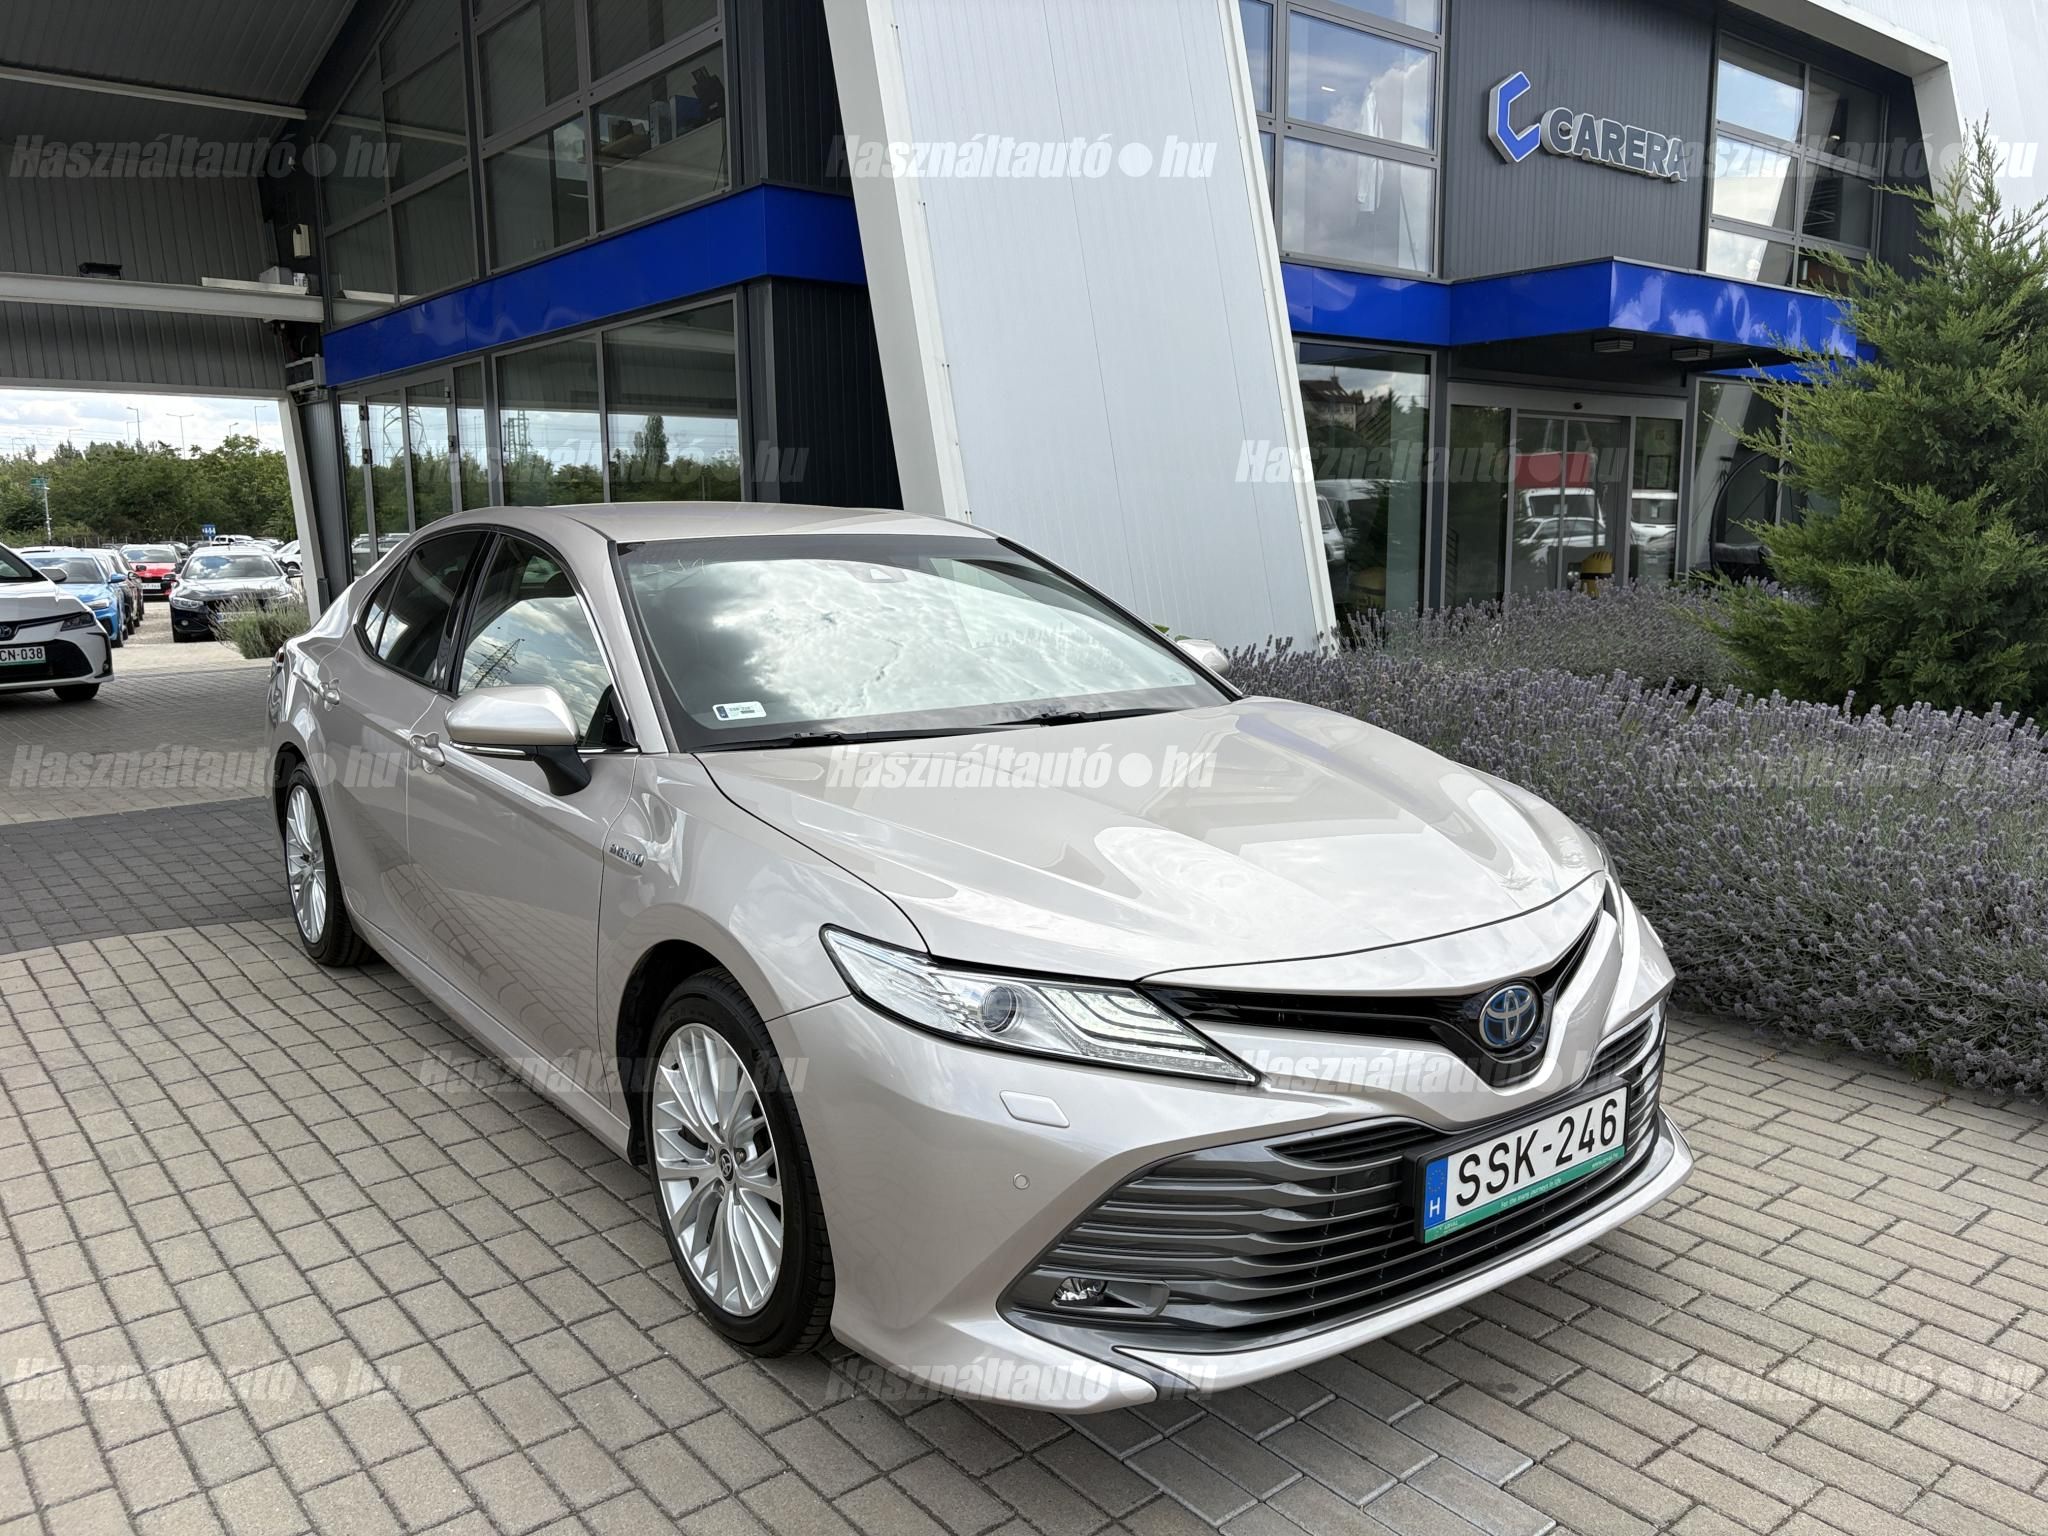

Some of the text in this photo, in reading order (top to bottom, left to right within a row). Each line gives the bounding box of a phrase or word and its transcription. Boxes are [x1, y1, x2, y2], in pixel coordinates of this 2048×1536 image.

[1543, 106, 1688, 182] CARERA
[1456, 1098, 1618, 1206] SSK-246
[1429, 1197, 1440, 1218] H
